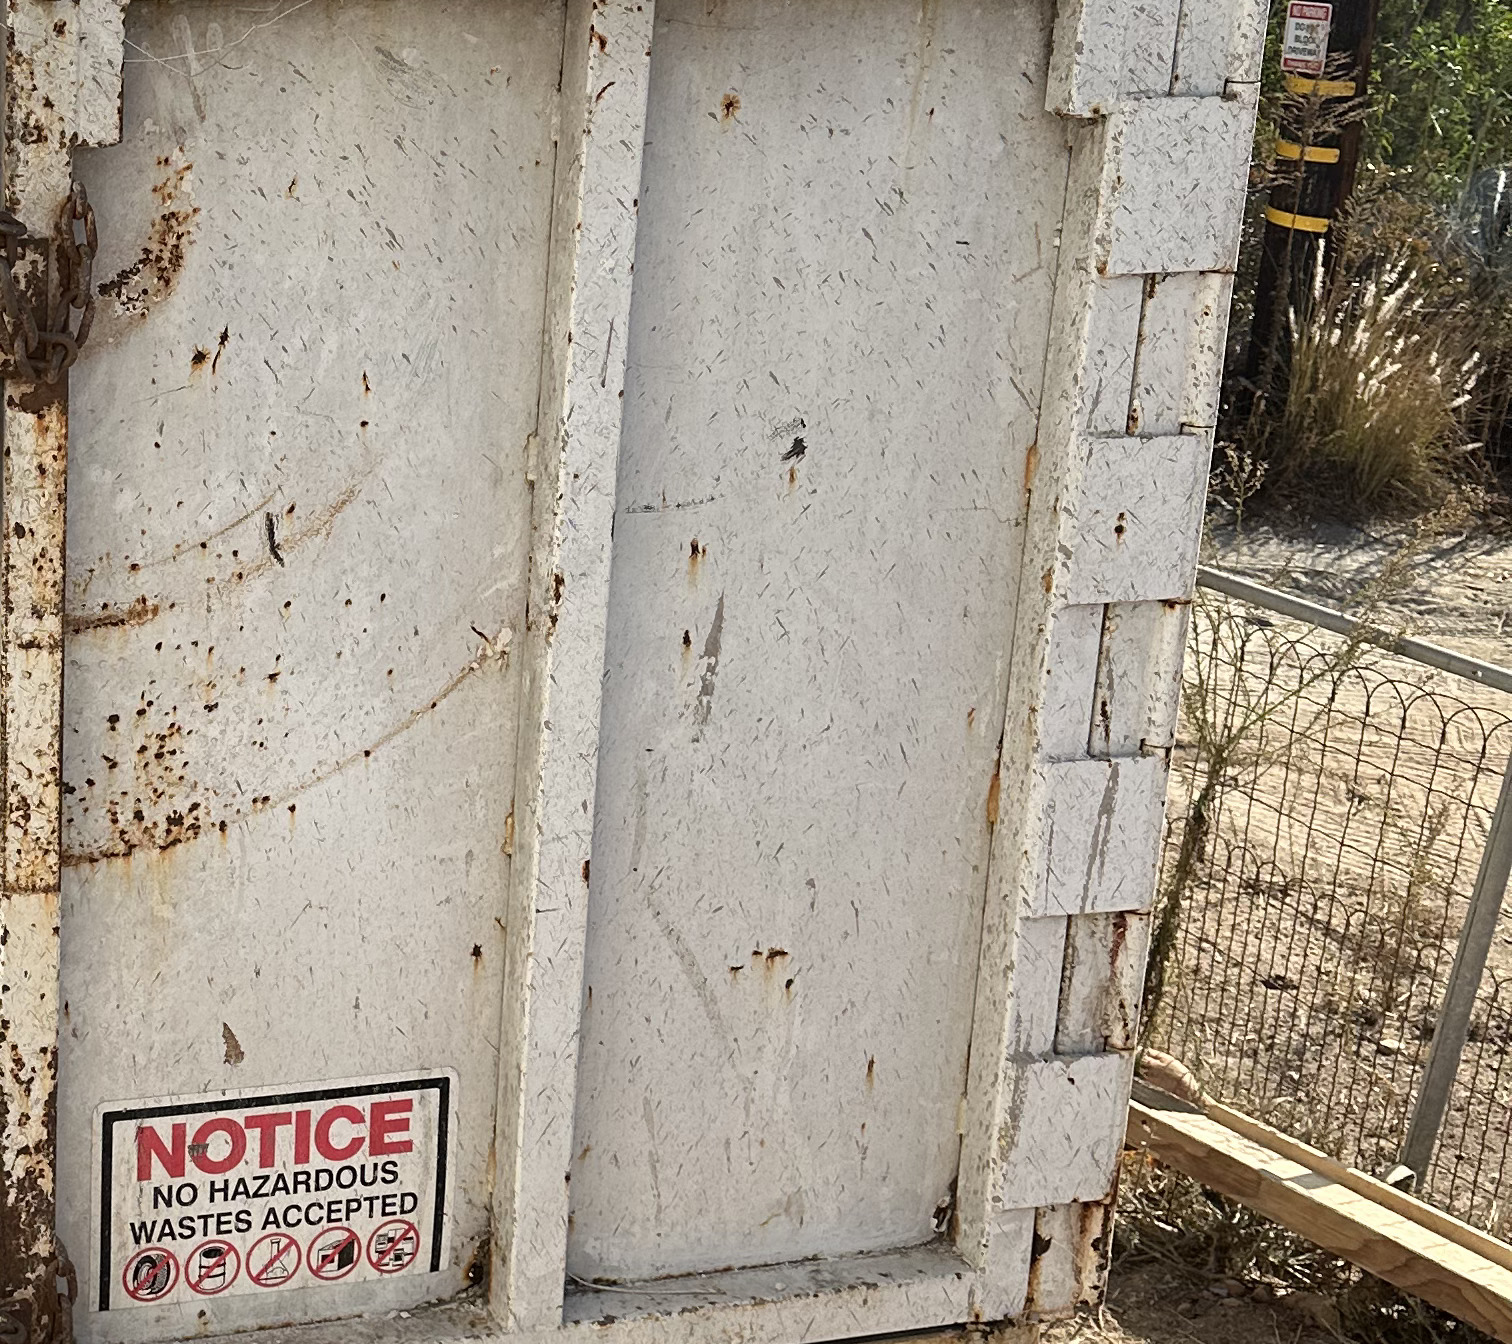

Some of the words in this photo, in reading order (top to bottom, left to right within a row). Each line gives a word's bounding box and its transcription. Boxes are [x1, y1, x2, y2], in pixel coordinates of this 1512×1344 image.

[135, 1098, 415, 1182] NOTICE
[152, 1181, 199, 1210] NO
[208, 1160, 399, 1204] HAZARDOUS
[129, 1210, 253, 1246] WASTES
[262, 1191, 419, 1231] ACCEPTED
